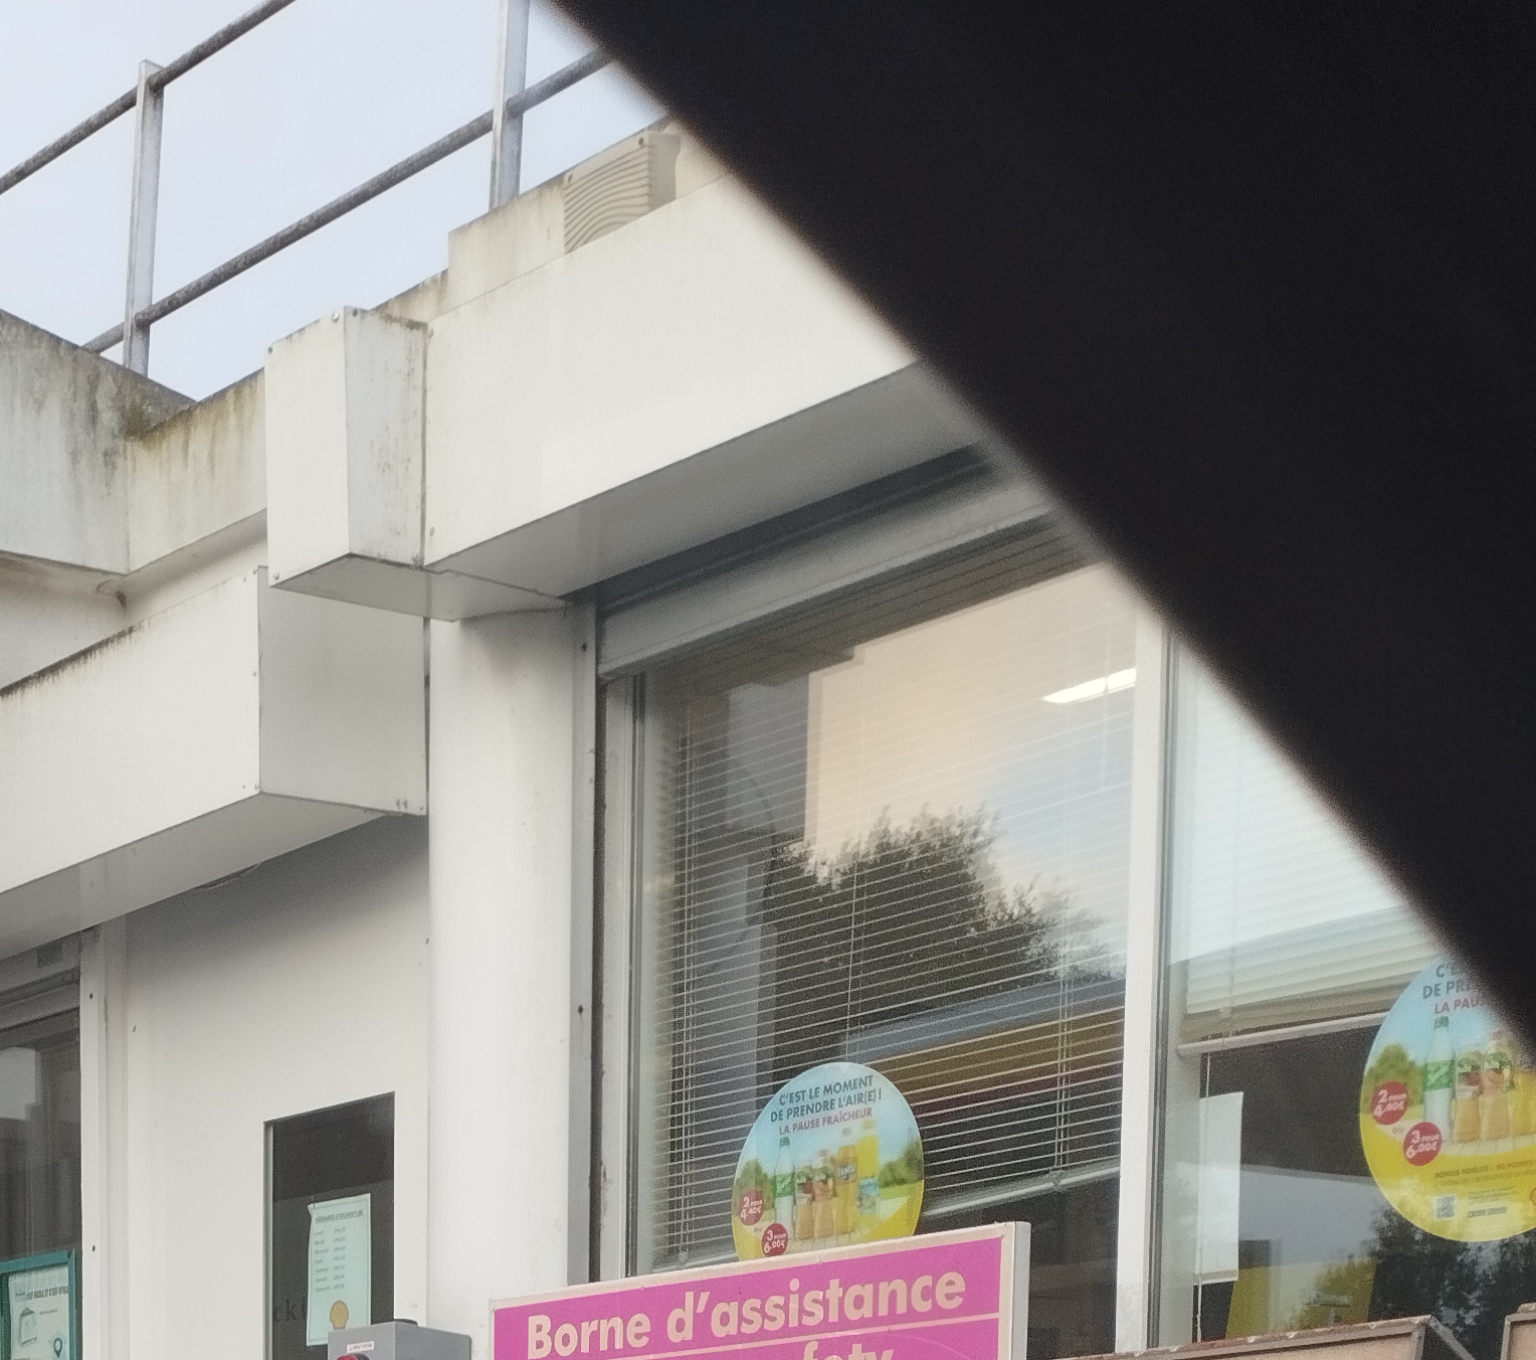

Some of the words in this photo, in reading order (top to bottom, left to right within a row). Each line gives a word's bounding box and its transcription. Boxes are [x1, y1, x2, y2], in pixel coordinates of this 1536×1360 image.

[1422, 983, 1442, 999] DE
[1434, 1001, 1450, 1015] LA
[779, 1090, 806, 1106] C'EST
[809, 1087, 820, 1100] LE
[822, 1075, 873, 1096] MOMENT
[1378, 1089, 1389, 1104] 2
[770, 1109, 784, 1123] DE
[786, 1098, 836, 1119] PRENDRE
[837, 1088, 877, 1108] L'AIR(E)
[779, 1123, 791, 1135] LA
[792, 1117, 820, 1133] PAUSE
[822, 1106, 873, 1127] FRAÎCHEUR
[1411, 1130, 1421, 1144] 3
[743, 1196, 750, 1209] 2
[766, 1229, 774, 1241] 3
[527, 1307, 651, 1360] Borne
[666, 1270, 966, 1344] d'assistance
